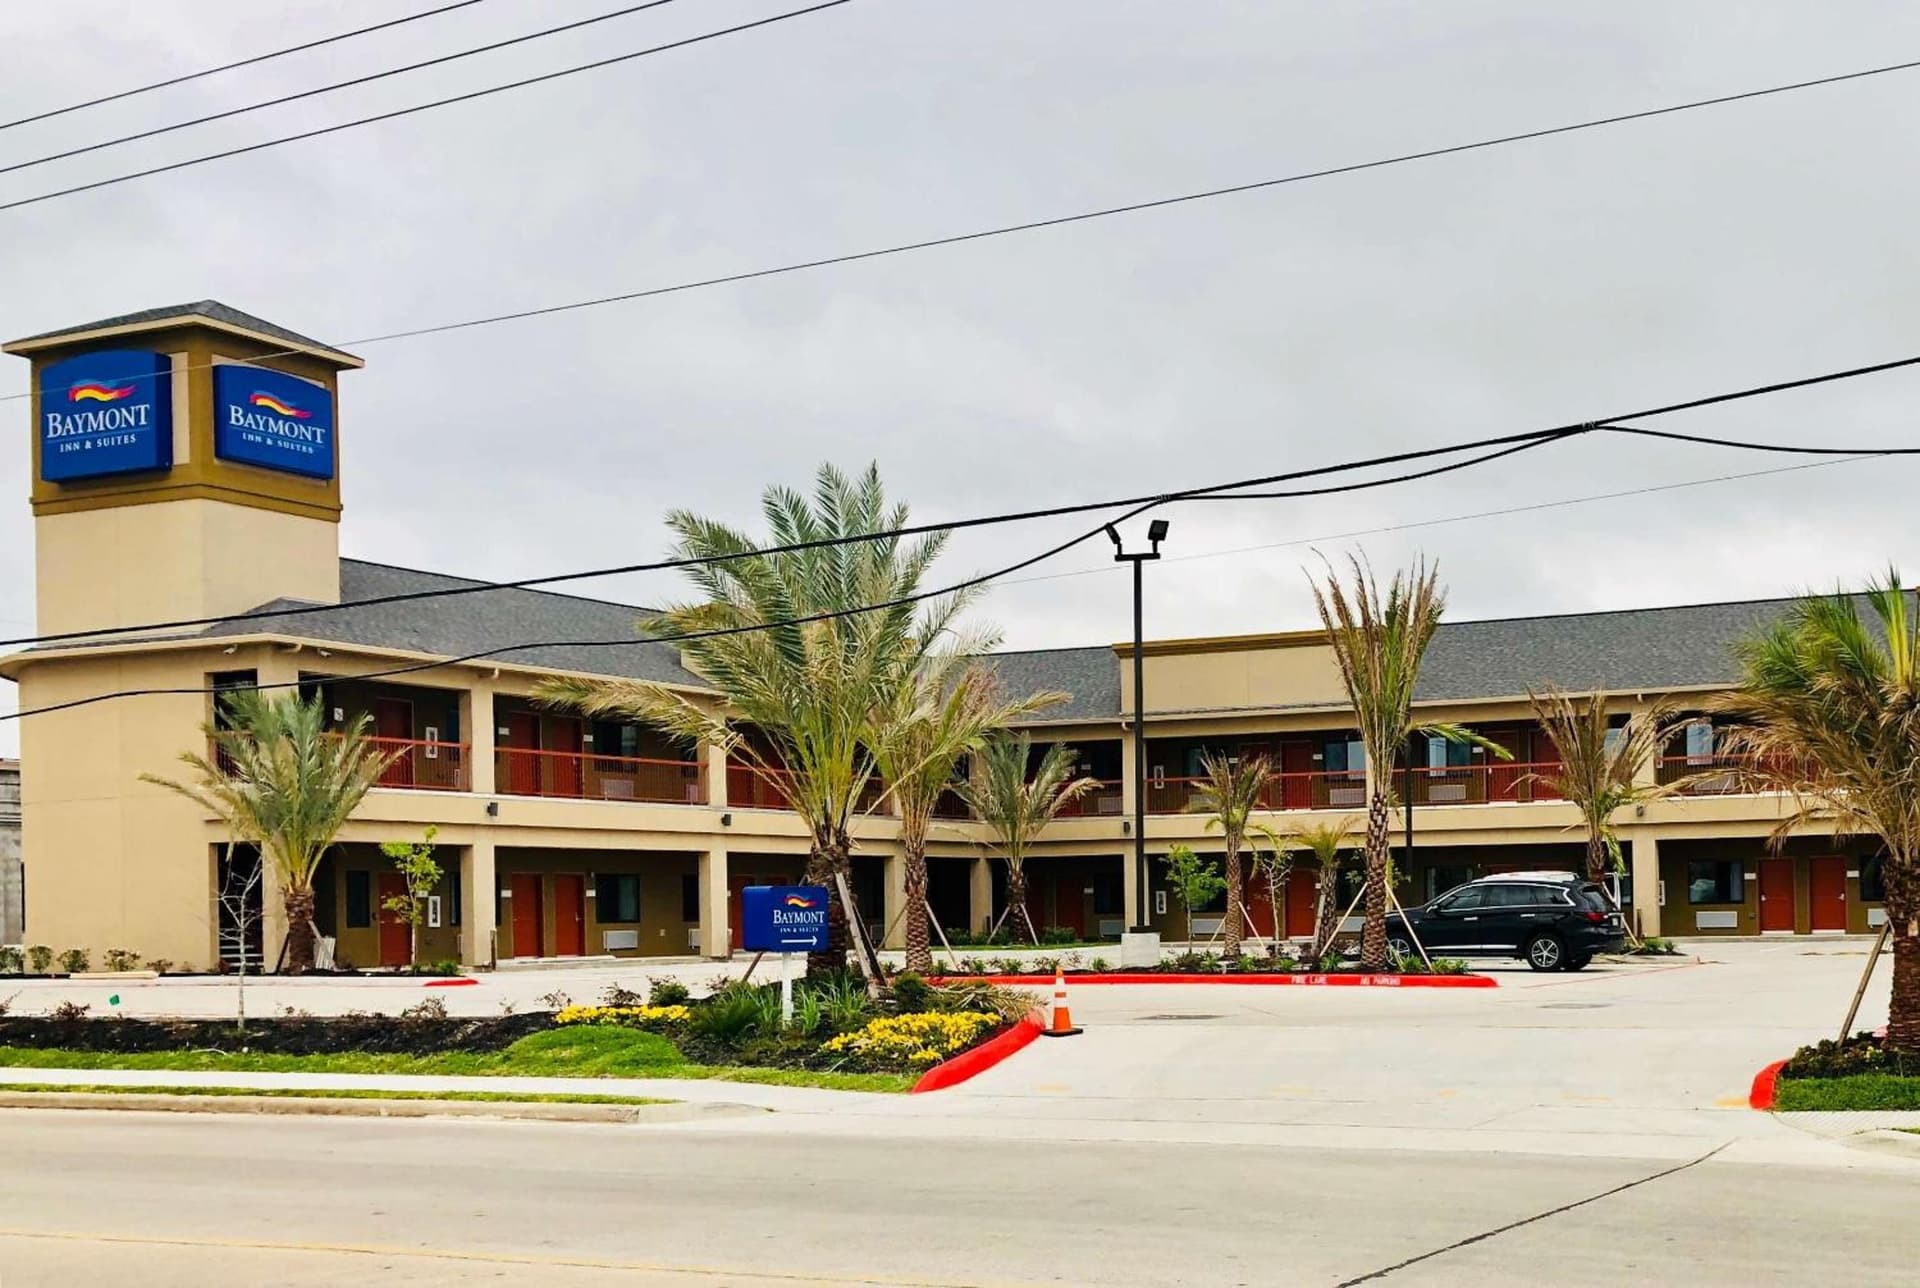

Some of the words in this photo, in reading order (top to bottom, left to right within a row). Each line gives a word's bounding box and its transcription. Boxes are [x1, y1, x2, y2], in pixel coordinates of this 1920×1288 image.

[47, 403, 150, 438] BAYMONT
[229, 404, 325, 444] BAYMONT
[59, 442, 80, 453] INN
[84, 439, 93, 449] &
[96, 433, 137, 448] SUITES
[242, 431, 262, 442] INN
[266, 436, 273, 445] &
[277, 438, 314, 454] SUITES
[773, 910, 825, 924] BAYMONT
